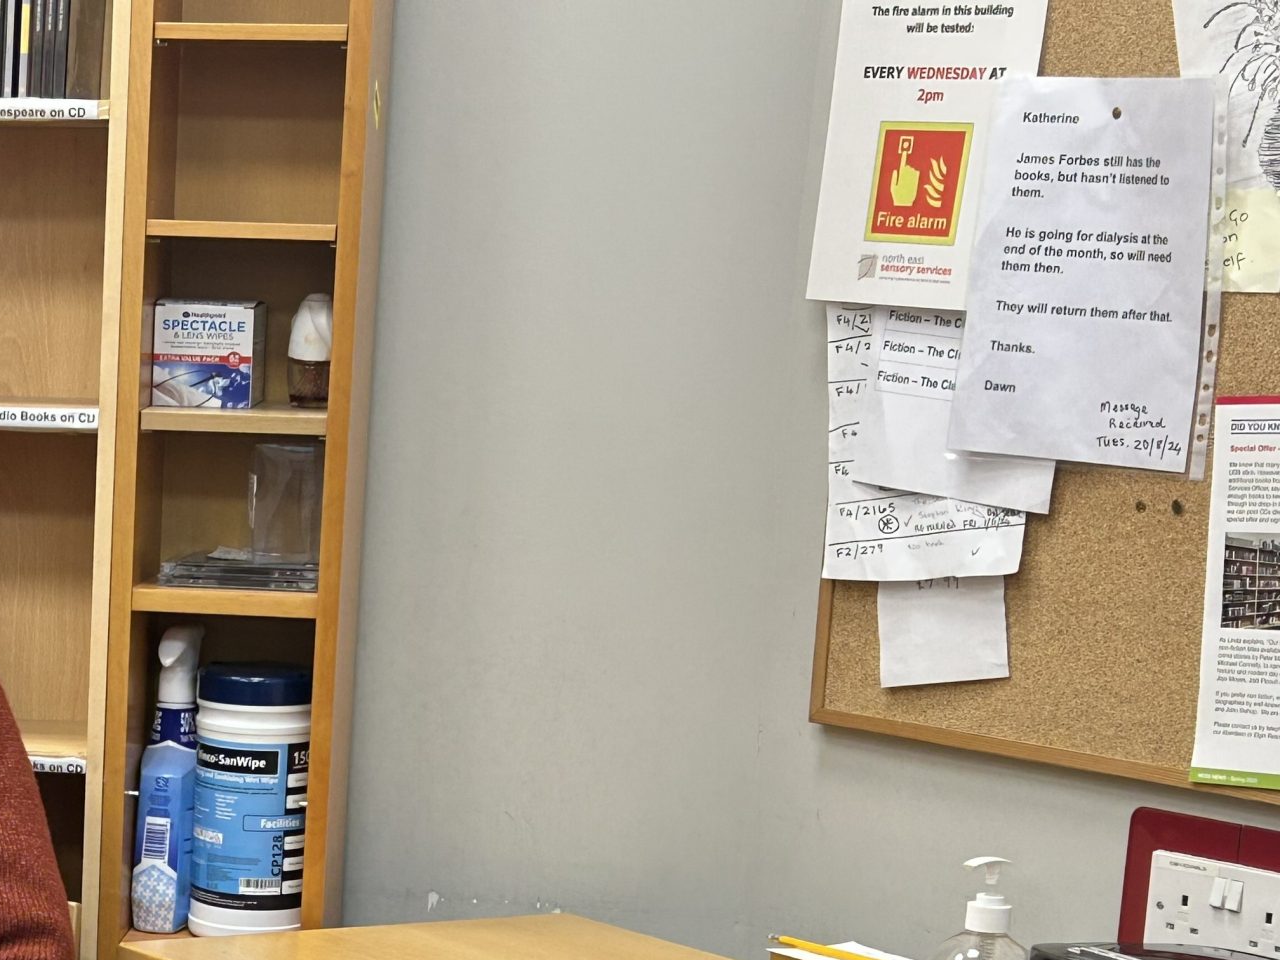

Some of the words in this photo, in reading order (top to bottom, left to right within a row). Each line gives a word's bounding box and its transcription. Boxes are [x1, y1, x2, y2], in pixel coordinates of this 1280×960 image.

[872, 6, 891, 17] The
[892, 6, 909, 17] fire
[910, 6, 939, 17] alarm
[941, 6, 951, 16] in
[954, 5, 972, 16] this
[974, 5, 1014, 18] building
[906, 23, 924, 33] will
[926, 23, 938, 33] be
[940, 23, 975, 34] tested:
[863, 66, 904, 80] EVERY
[907, 67, 986, 80] WEDNESDAY
[988, 67, 1007, 80] AT
[917, 89, 944, 104] 2pm
[50, 109, 64, 118] on
[68, 107, 86, 118] CD
[1023, 112, 1080, 125] Katherine
[1016, 153, 1055, 166] James
[1058, 154, 1100, 167] Forbes
[1103, 155, 1123, 168] still
[1126, 157, 1143, 168] has
[1145, 156, 1161, 168] the
[1013, 170, 1054, 183] books,
[1057, 171, 1077, 183] but
[1081, 172, 1117, 184] hasn't
[1119, 173, 1157, 186] listened
[1159, 175, 1170, 186] to
[1011, 186, 1045, 199] them.
[876, 212, 904, 228] Fire
[907, 213, 947, 230] alarm
[1005, 227, 1022, 239] He
[1024, 228, 1036, 240] is
[1039, 230, 1074, 244] going
[1076, 231, 1093, 242] for
[1096, 231, 1139, 246] dialysis
[1141, 234, 1151, 245] at
[1152, 234, 1168, 246] the
[1003, 244, 1025, 256] end
[1028, 244, 1042, 256] of
[1044, 246, 1063, 258] the
[1066, 248, 1107, 261] month,
[1109, 250, 1124, 260] so
[1126, 249, 1145, 262] will
[1147, 251, 1172, 263] need
[880, 264, 915, 277] sensory
[917, 265, 952, 277] services
[1001, 261, 1031, 273] them
[1033, 262, 1064, 275] then.
[889, 310, 922, 324] Fiction
[934, 315, 952, 326] The
[995, 301, 1024, 316] They
[1027, 302, 1047, 314] will
[1050, 304, 1087, 317] return
[1090, 306, 1119, 319] them
[1121, 308, 1148, 321] after
[1149, 310, 1173, 323] that.
[162, 319, 246, 332] SPECTACLE
[181, 332, 204, 341] LENS
[206, 332, 234, 341] WIPES
[883, 341, 916, 355] Fiction
[927, 346, 945, 358] The
[990, 340, 1036, 355] Thanks.
[877, 370, 910, 385] Fiction
[921, 376, 938, 389] The
[984, 380, 1016, 393] Dawn
[20, 411, 56, 422] Books
[60, 414, 75, 424] on
[1230, 423, 1246, 431] DID
[1247, 423, 1266, 431] YOU
[1133, 437, 1182, 460] 20/8/24
[1230, 445, 1257, 453] Special
[49, 764, 63, 772] on
[66, 763, 83, 773] CD
[260, 817, 300, 829] Facilities
[271, 835, 282, 877] CP128
